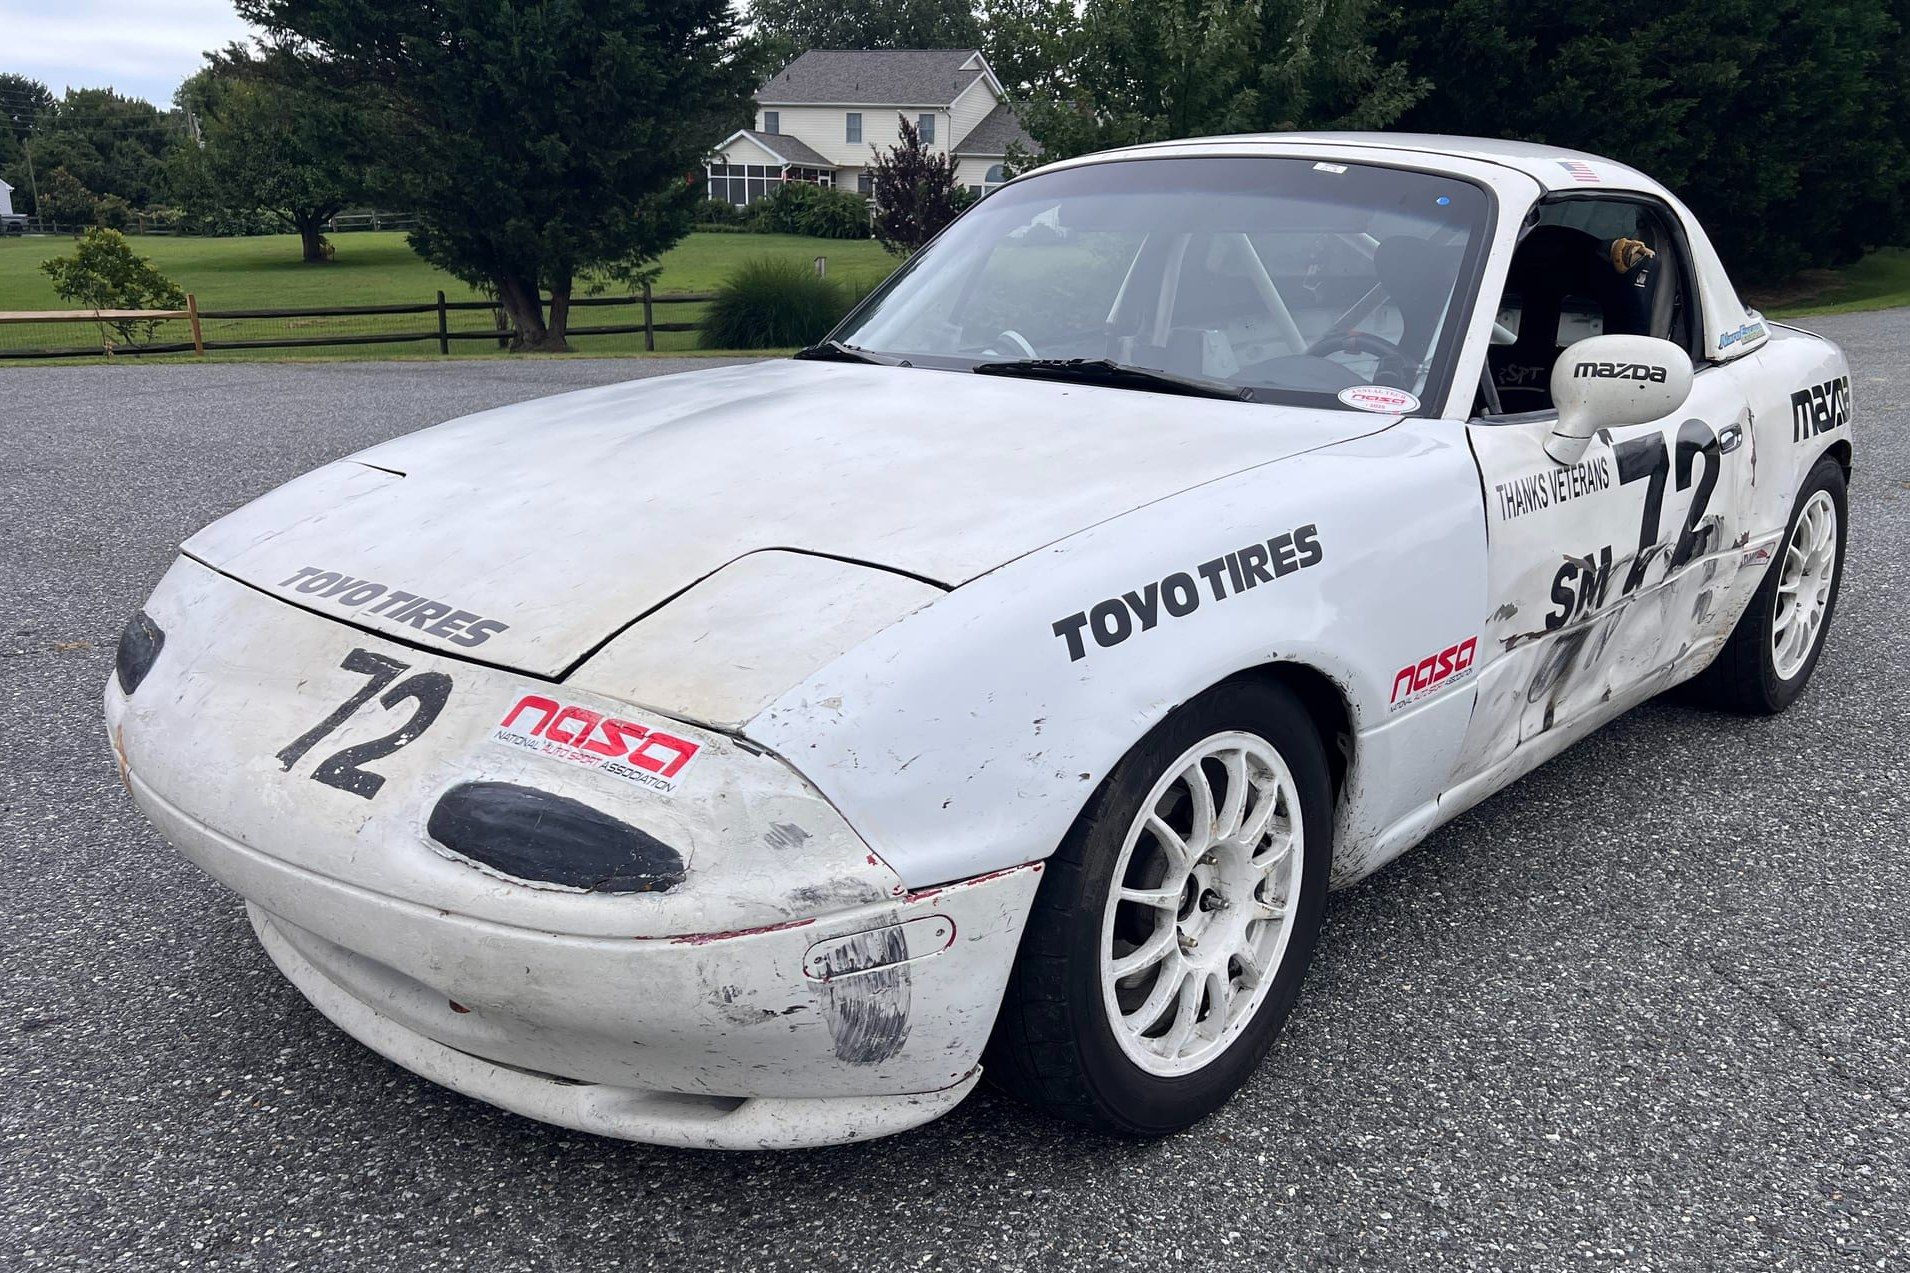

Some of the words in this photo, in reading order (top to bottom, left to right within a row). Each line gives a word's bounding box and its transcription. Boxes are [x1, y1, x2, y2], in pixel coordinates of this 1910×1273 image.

[1574, 362, 1667, 383] mazda
[1496, 473, 1548, 521] THANKS
[1547, 456, 1610, 505] VETERANS
[1613, 418, 1721, 596] 72
[277, 566, 389, 607] TOYO
[367, 590, 511, 648] TIRES
[1051, 571, 1200, 663] TOYO
[1197, 523, 1324, 602] TIRES
[1545, 545, 1613, 631] SM
[1390, 636, 1477, 704] nasa
[275, 647, 454, 801] 72
[493, 730, 540, 751] NATIONAL
[540, 741, 568, 760] AUTO
[566, 750, 604, 767] SPORT
[599, 760, 676, 793] ASSOCIATION
[500, 695, 701, 778] nasa
